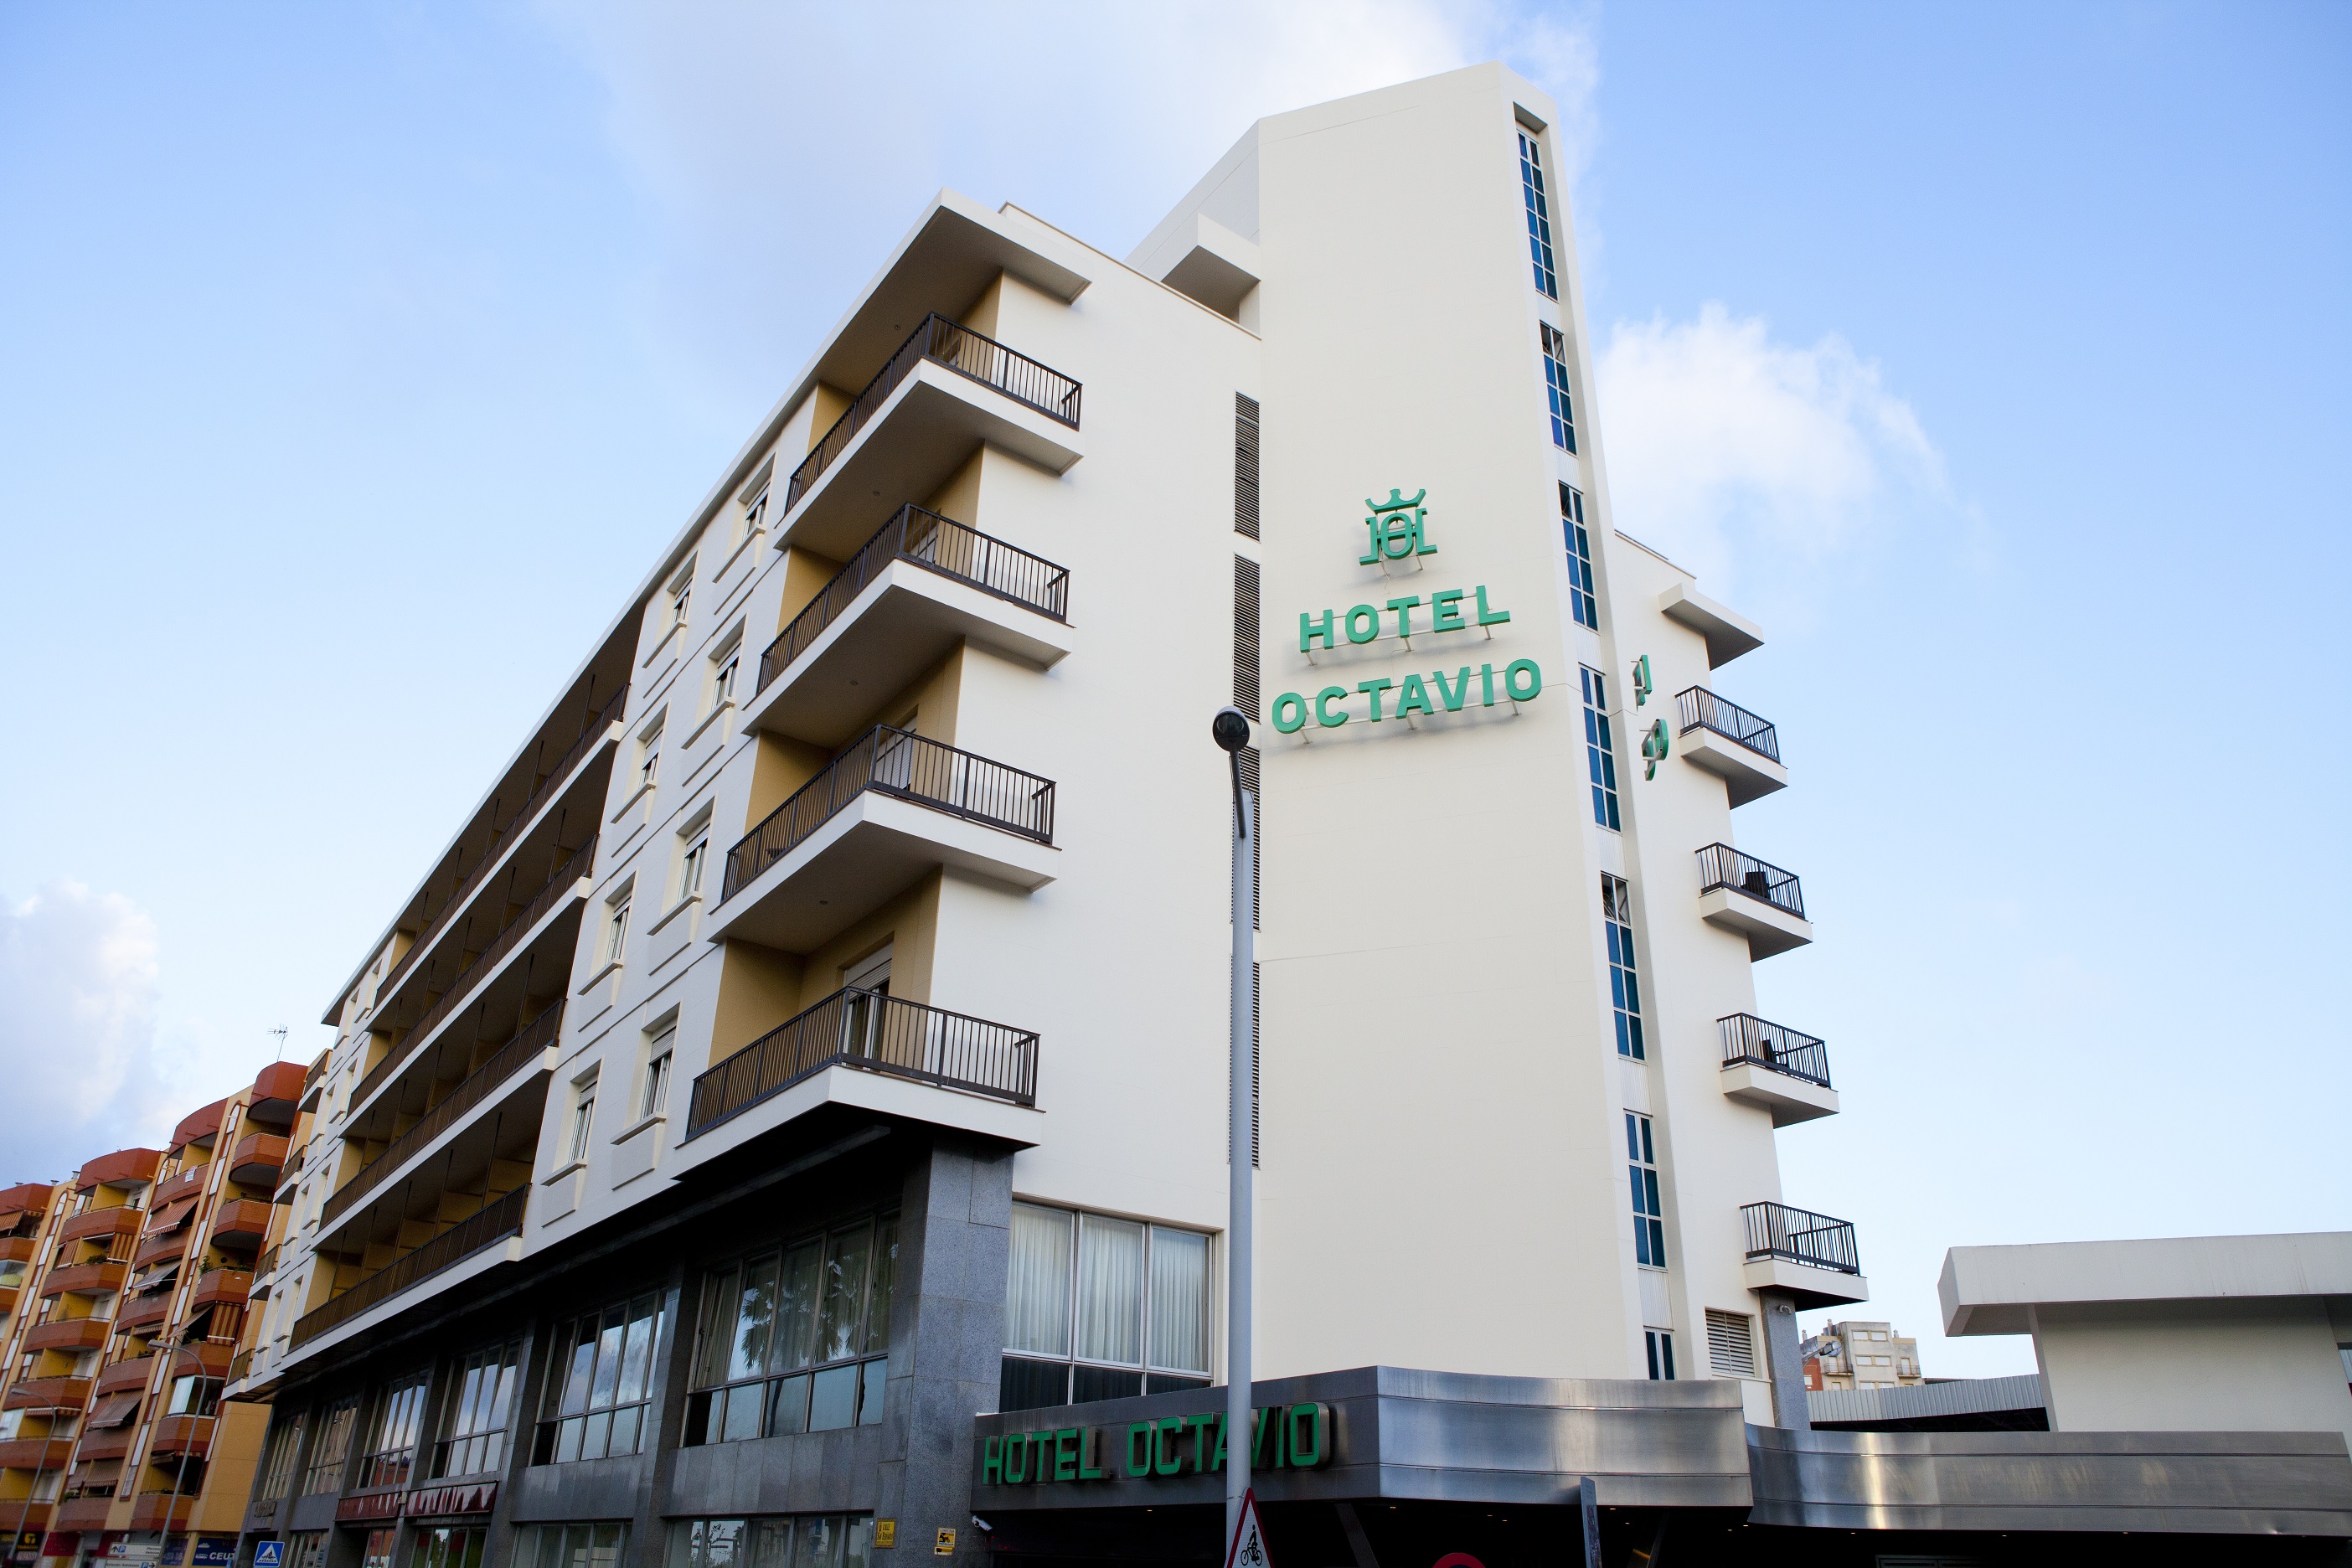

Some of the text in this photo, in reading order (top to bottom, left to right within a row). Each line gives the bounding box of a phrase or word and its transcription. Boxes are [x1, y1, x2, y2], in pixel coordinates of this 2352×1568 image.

[1300, 585, 1510, 653] HOTEL
[1271, 658, 1542, 735] OCTAVIO
[983, 1426, 1105, 1485] HOTEL
